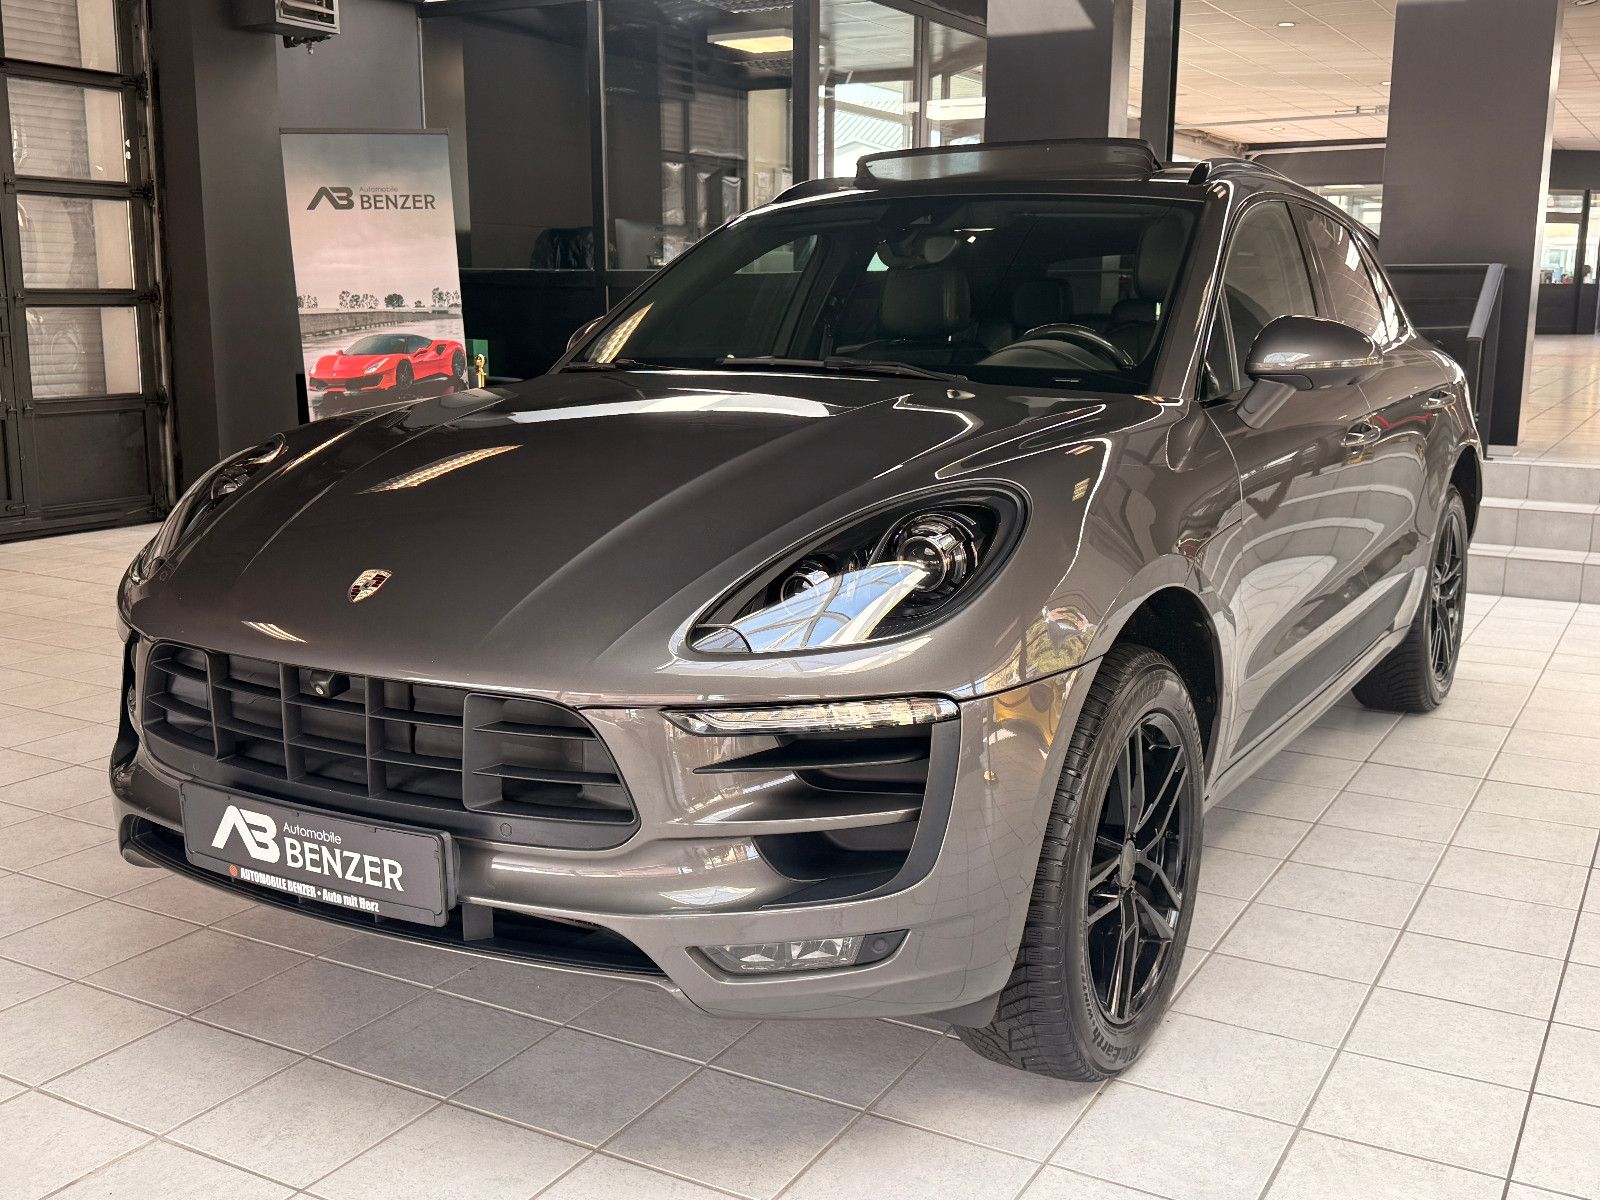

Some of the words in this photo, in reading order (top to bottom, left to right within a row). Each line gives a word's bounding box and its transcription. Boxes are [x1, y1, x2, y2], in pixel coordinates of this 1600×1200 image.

[360, 194, 436, 210] BENZER
[283, 821, 342, 845] Automobile
[283, 837, 404, 892] BENZER
[240, 867, 287, 891] AUTOMOBILE
[287, 880, 316, 899] BENZER
[322, 888, 342, 906] Auto
[343, 895, 359, 908] mit
[358, 897, 380, 913] Herz
